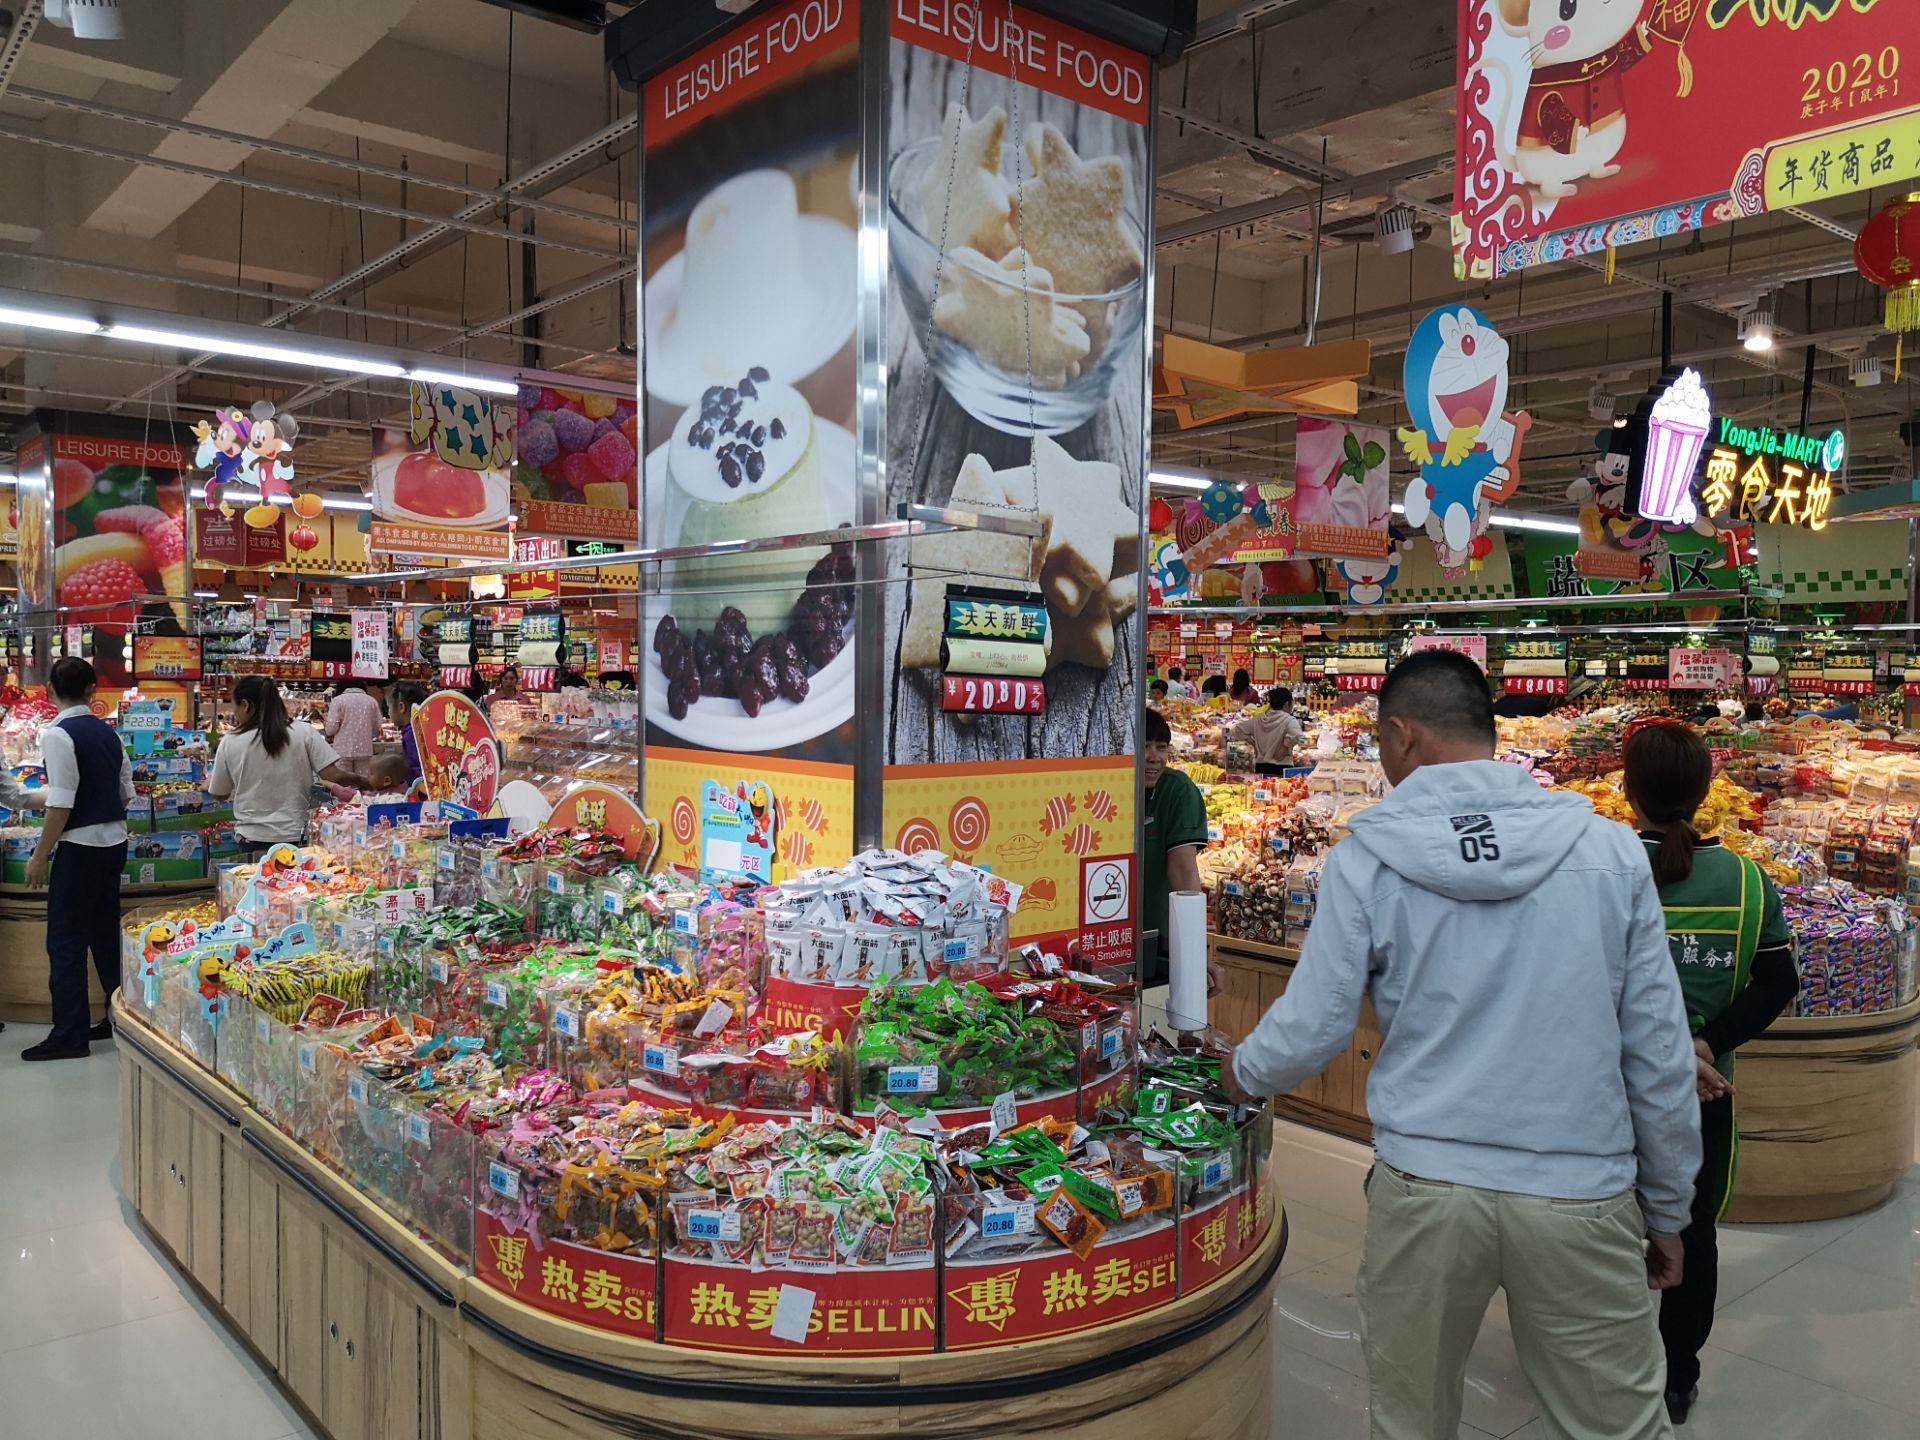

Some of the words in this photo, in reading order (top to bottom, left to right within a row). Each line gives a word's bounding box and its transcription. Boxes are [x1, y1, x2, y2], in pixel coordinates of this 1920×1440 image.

[665, 34, 760, 119] LEISURE
[767, 0, 842, 64] FOOD
[897, 0, 1047, 72] LEISURE
[1056, 40, 1143, 104] FOOD
[1800, 46, 1900, 102] 2020
[1778, 137, 1894, 199] 年货商品
[57, 439, 131, 460] LEISURE
[135, 447, 183, 463] FOOD
[1720, 417, 1824, 463] YongJia-MART
[1702, 448, 1831, 531] 零食天地
[202, 536, 237, 547] 过磅处
[964, 609, 1035, 632] 天天新鲜
[1459, 834, 1500, 863] 05
[1082, 927, 1133, 952] 禁止吸烟
[1097, 948, 1132, 961] Smoking
[891, 1078, 918, 1088] 20.80
[691, 1222, 719, 1235] 20.80
[986, 1219, 1014, 1232] 20.80
[496, 1234, 526, 1281] 惠
[542, 1256, 623, 1316] 热卖
[965, 1277, 1017, 1323] 惠
[1041, 1257, 1133, 1316] 热卖
